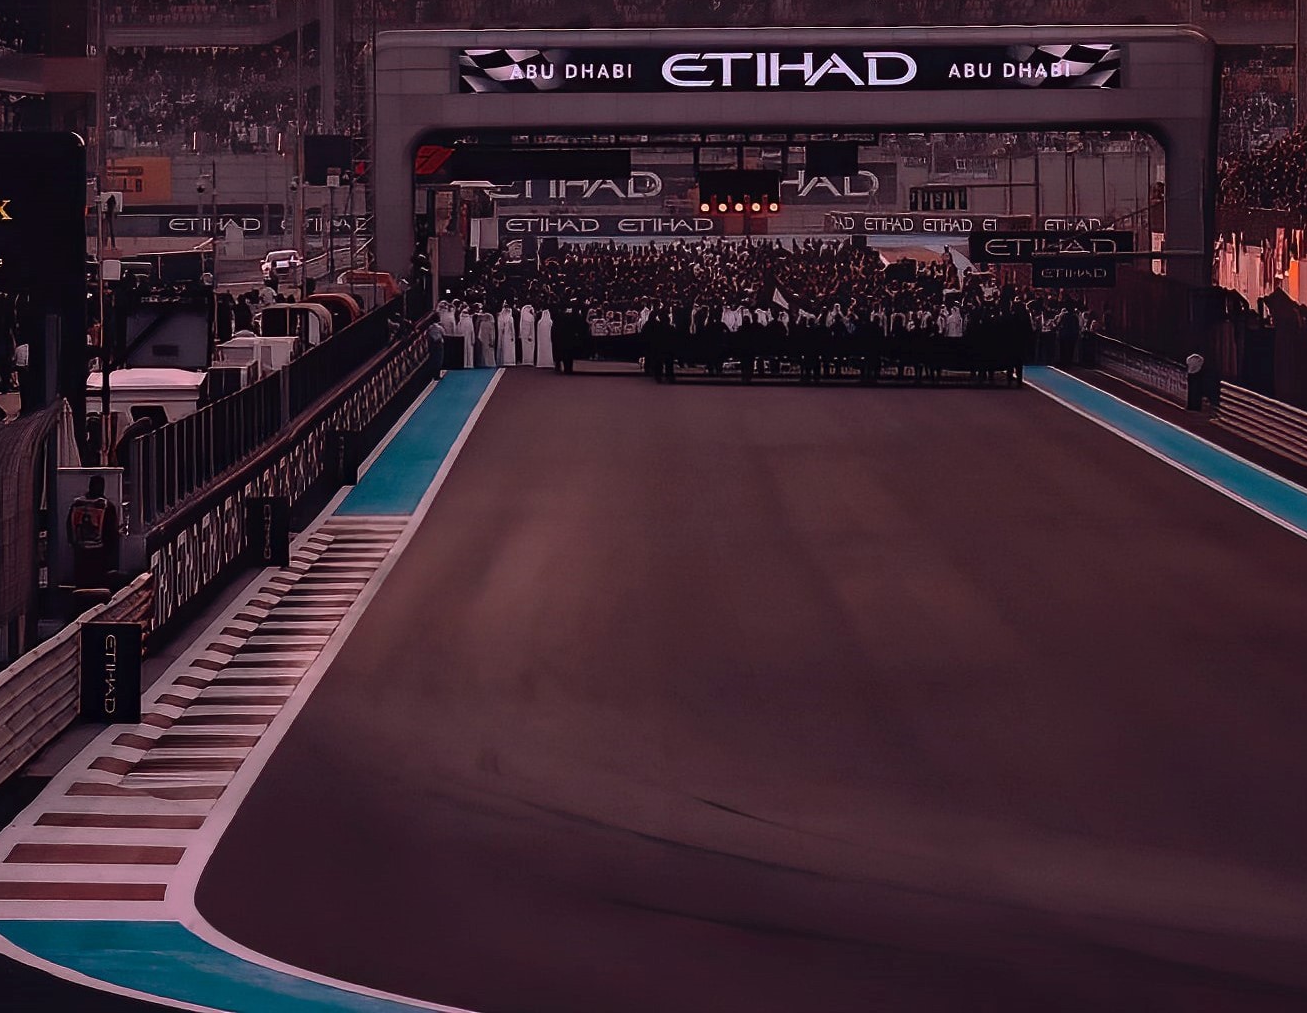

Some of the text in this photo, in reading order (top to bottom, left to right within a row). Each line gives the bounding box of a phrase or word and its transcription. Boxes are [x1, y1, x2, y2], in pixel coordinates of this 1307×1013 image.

[508, 61, 633, 80] ABU DHABI
[661, 51, 918, 86] ETIHAD
[948, 60, 1071, 79] ABU DHABI
[168, 218, 261, 231] ETIHAD
[506, 218, 714, 232] ETIHAD ETIHAD
[864, 217, 914, 232] ETIHAD
[922, 218, 973, 232] ETIHAD
[104, 634, 116, 714] ETIHAD
